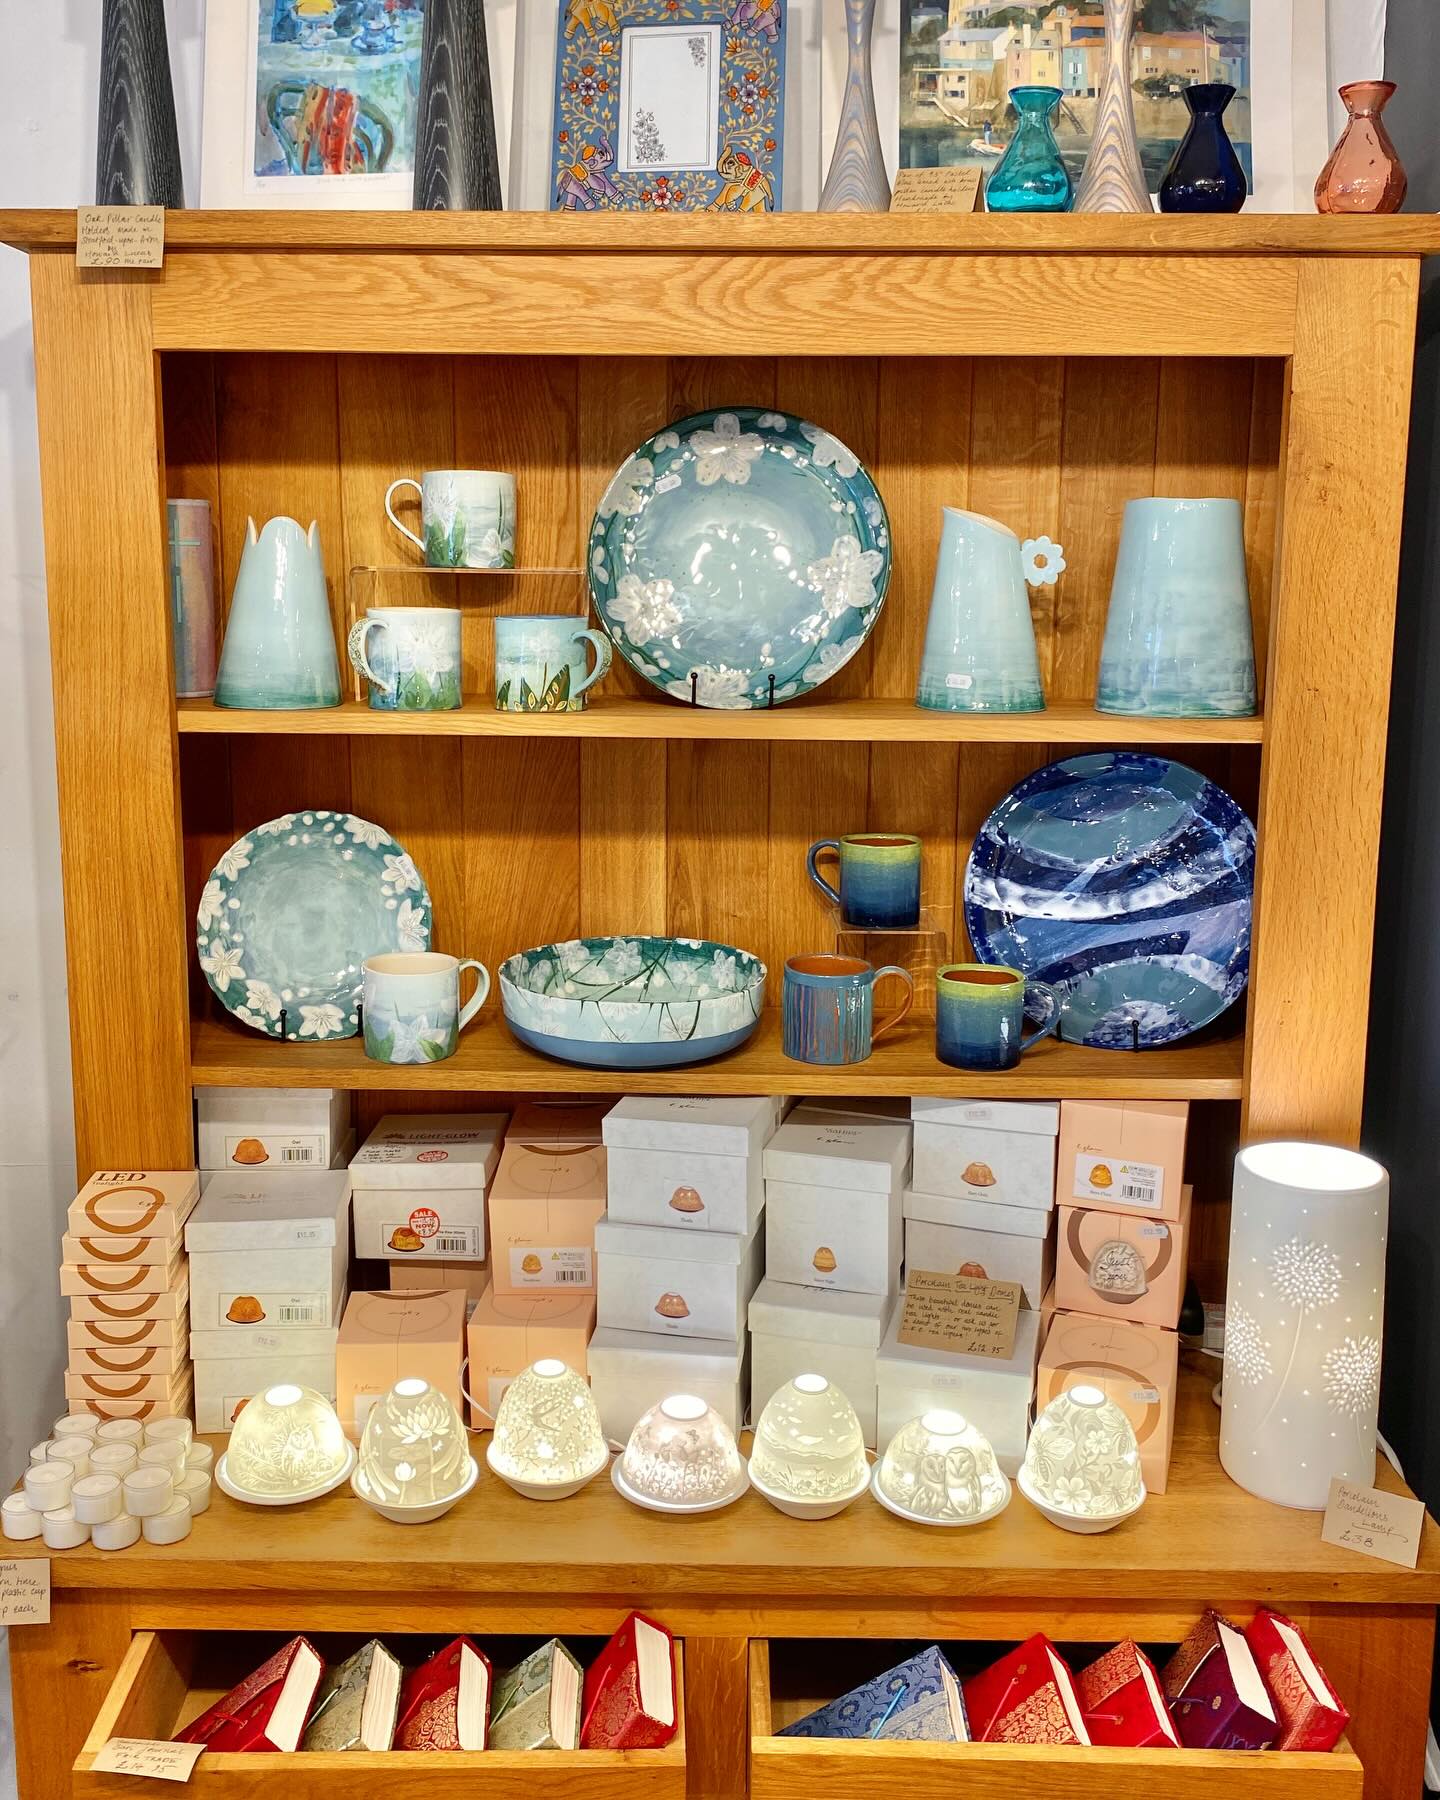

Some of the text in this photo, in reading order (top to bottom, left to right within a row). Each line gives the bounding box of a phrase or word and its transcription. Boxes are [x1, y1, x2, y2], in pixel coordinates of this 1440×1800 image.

[97, 1173, 147, 1182] LED
[414, 1210, 433, 1218] SALE
[1, 1587, 26, 1600] plastic
